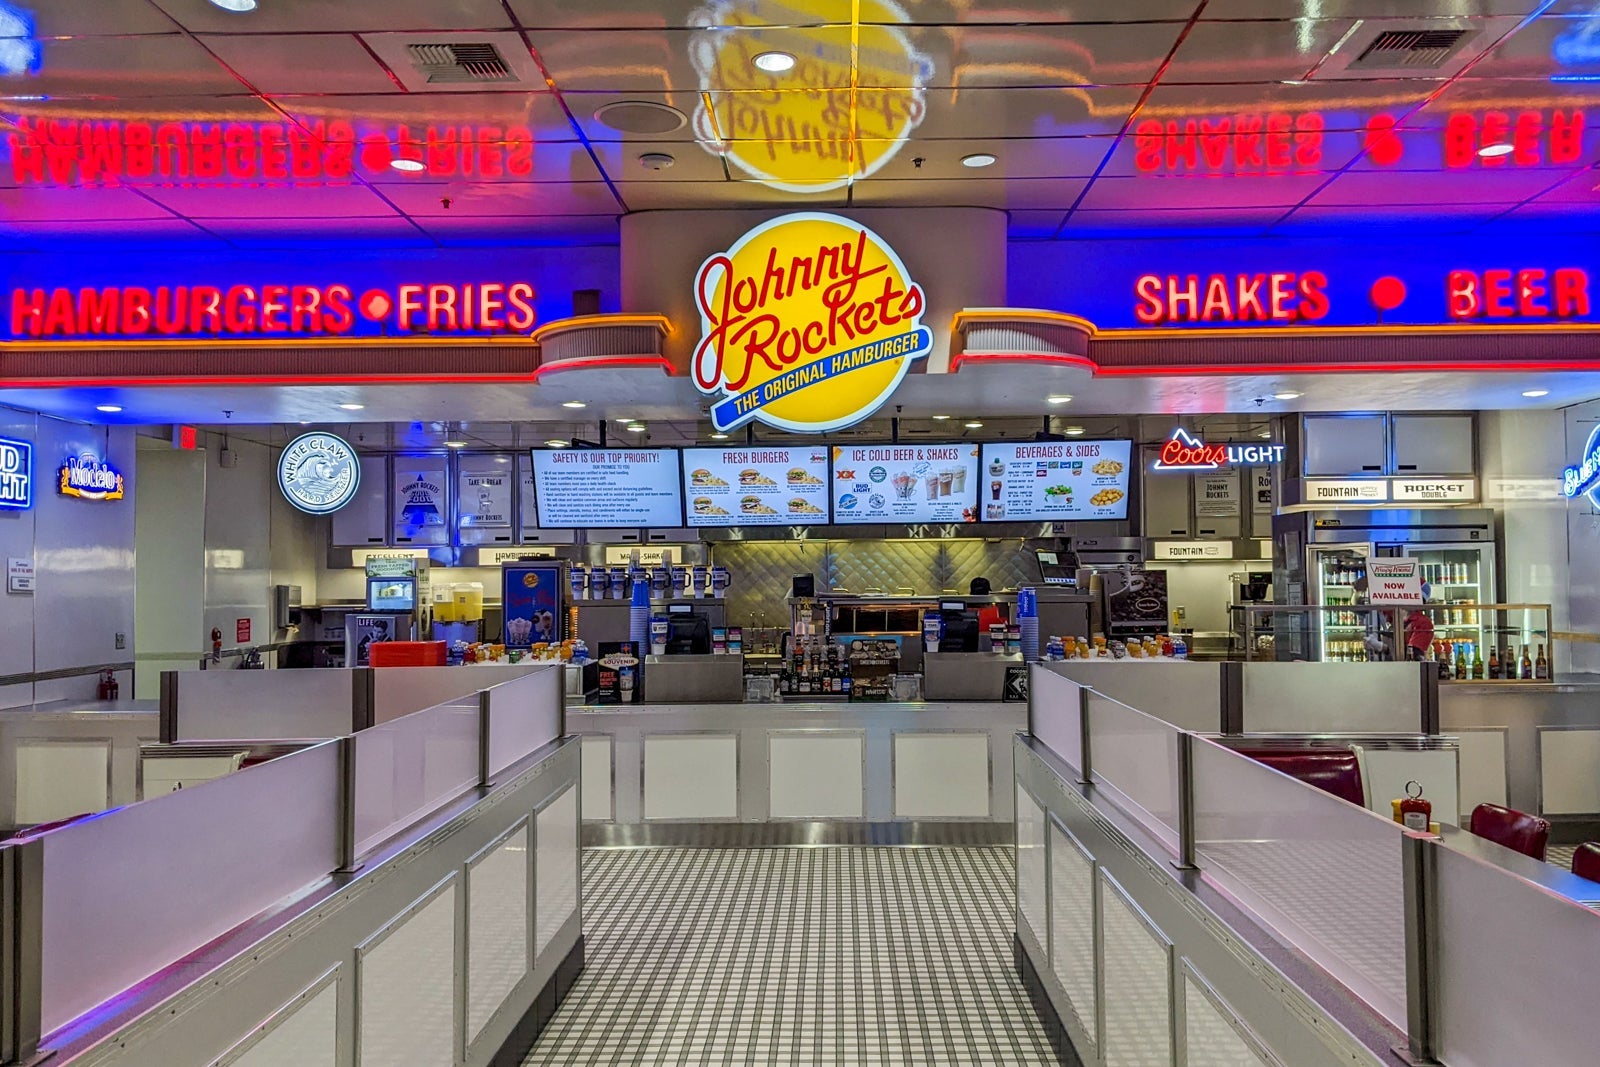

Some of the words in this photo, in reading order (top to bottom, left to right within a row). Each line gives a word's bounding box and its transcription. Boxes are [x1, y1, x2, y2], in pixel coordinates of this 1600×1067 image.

[1135, 271, 1329, 322] SHAKES
[1448, 267, 1590, 317] BEER
[10, 284, 352, 335] HAMBURGERS
[397, 281, 535, 330] FRIES
[695, 230, 888, 389] Johnny
[725, 277, 922, 391] Rockets
[733, 389, 761, 415] THE
[764, 361, 827, 400] ORIGINAL
[831, 333, 919, 373] HAMBURGER
[286, 443, 307, 483] WHITE
[310, 440, 347, 460] CLAW
[552, 453, 579, 463] SAFETY
[581, 453, 587, 463] IS
[590, 453, 605, 463] OUR
[608, 453, 621, 463] TOP
[624, 453, 660, 463] PRIORITY!
[723, 452, 748, 464] FRESH
[751, 451, 789, 463] BURGERS
[853, 450, 866, 461] ICE
[869, 450, 890, 461] COLD
[893, 449, 914, 460] BEER
[917, 449, 924, 460] &
[927, 448, 959, 460] SHAKES
[1016, 446, 1062, 458] BEVERAGES
[1065, 446, 1073, 457] &
[1076, 445, 1100, 457] SIDES
[1162, 440, 1229, 464] Coors
[1228, 446, 1284, 463] LIGHT
[70, 458, 115, 489] Modelo
[297, 488, 320, 502] HARD
[401, 482, 419, 494] JOHNNY
[420, 482, 440, 494] ROCKETS
[1318, 488, 1358, 497] FOUNTAIN
